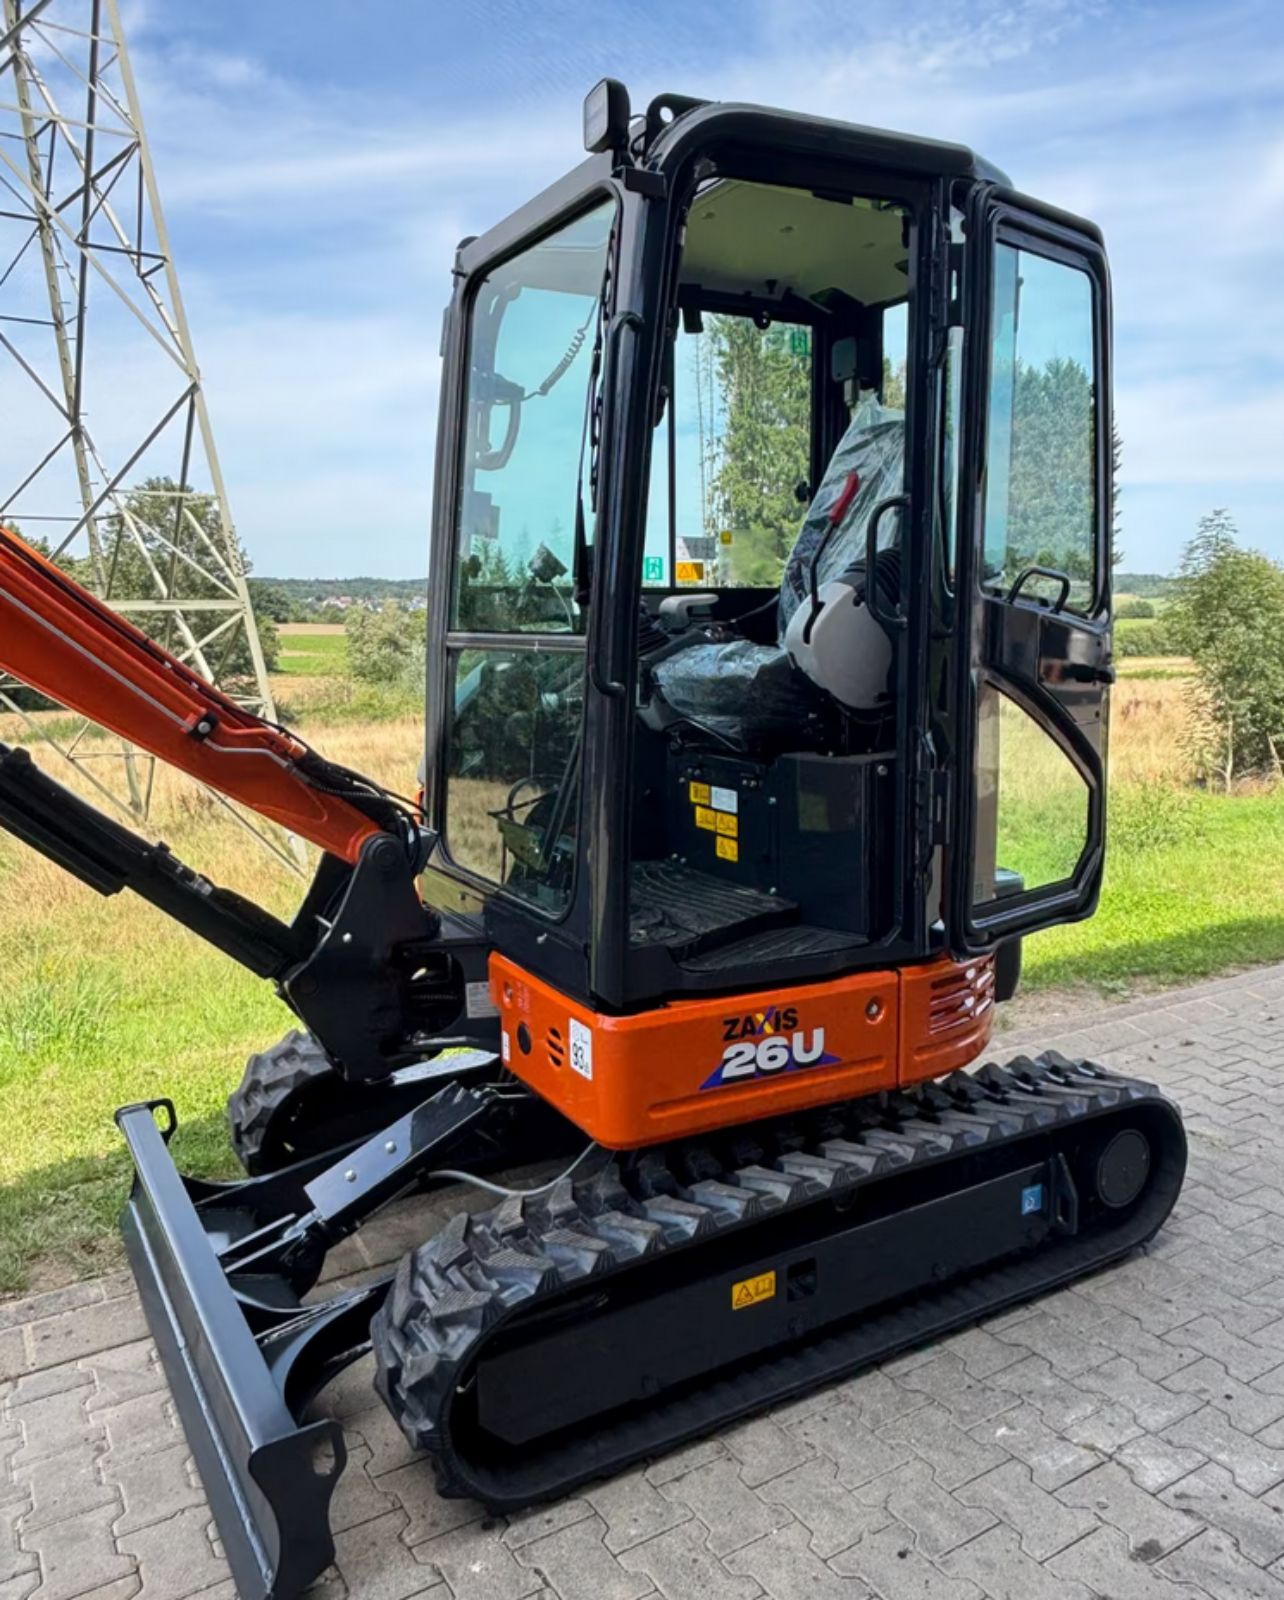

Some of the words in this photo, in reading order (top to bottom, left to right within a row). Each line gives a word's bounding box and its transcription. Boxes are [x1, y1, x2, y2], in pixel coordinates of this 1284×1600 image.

[722, 1006, 798, 1041] ZAXIS
[572, 1041, 585, 1070] 93
[721, 1027, 825, 1081] 26U
